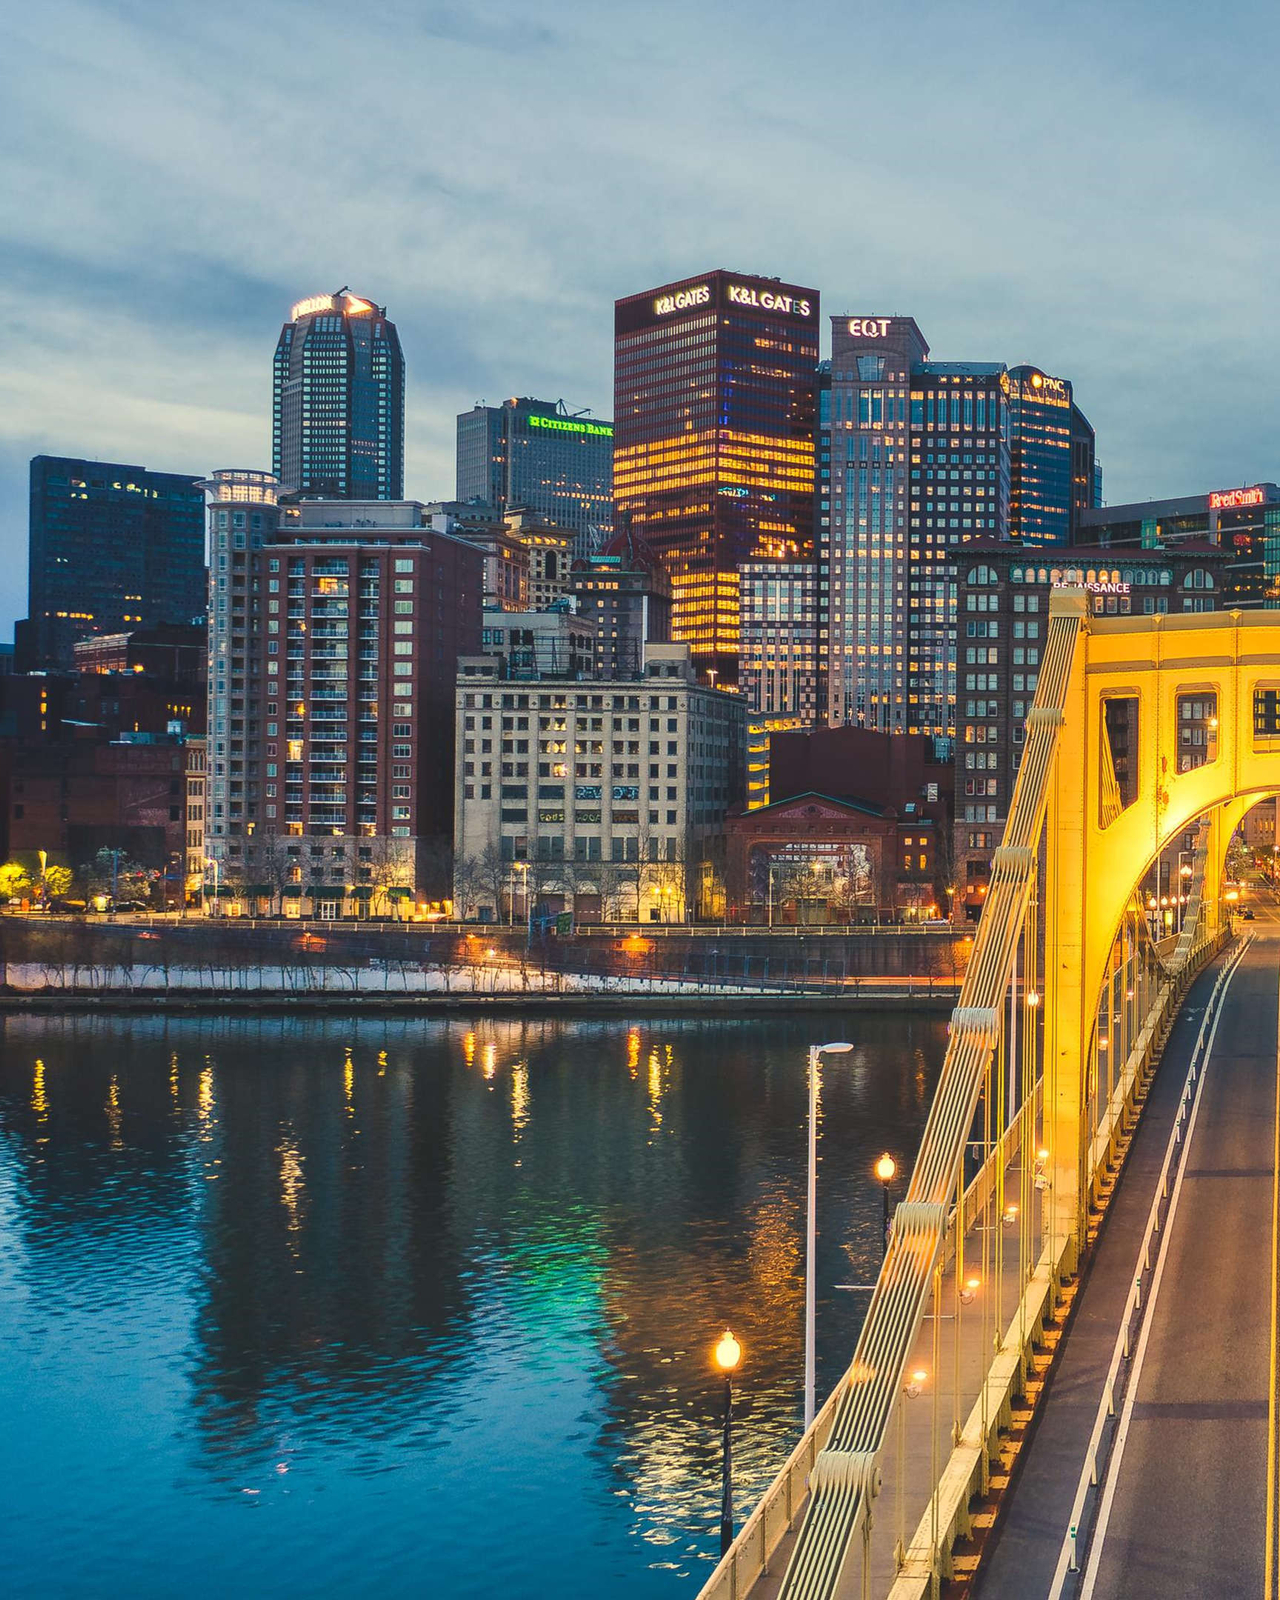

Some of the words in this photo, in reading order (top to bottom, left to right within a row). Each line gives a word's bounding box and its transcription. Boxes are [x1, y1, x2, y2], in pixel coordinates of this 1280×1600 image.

[655, 296, 676, 315] K&L
[675, 286, 710, 309] GATES
[729, 285, 760, 307] K&L
[760, 292, 811, 317] GATES
[849, 319, 892, 338] EQT
[1042, 377, 1065, 392] PNC
[540, 417, 586, 433] CITIZENS
[586, 423, 614, 437] BANK
